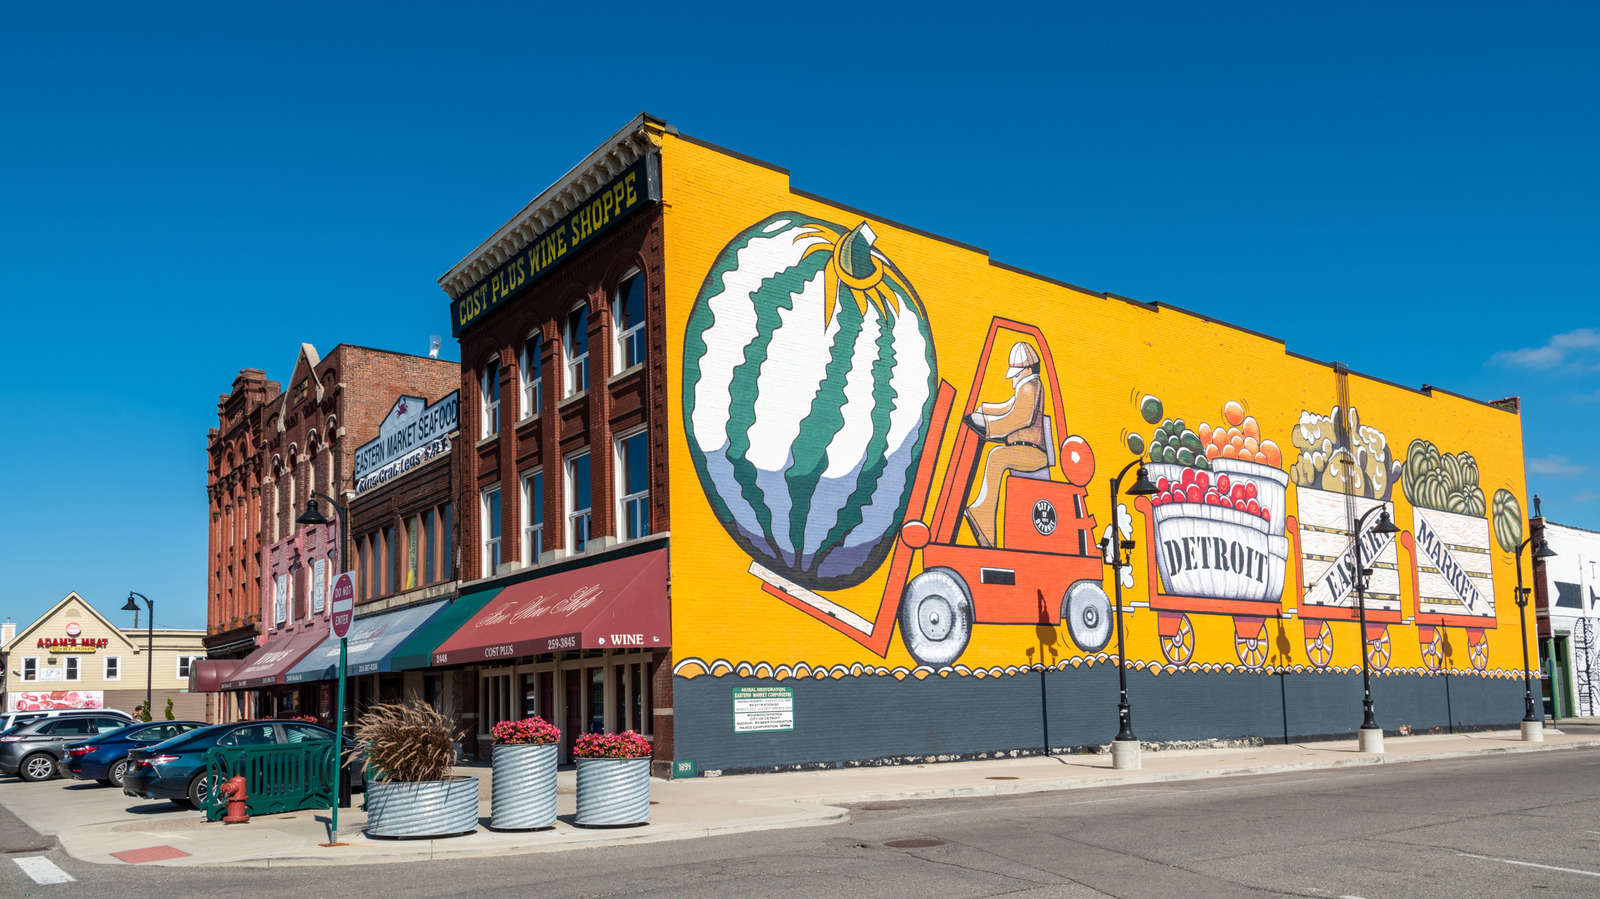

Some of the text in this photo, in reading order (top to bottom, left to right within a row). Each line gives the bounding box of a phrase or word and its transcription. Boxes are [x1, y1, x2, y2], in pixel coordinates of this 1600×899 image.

[459, 171, 637, 326] COST PLUS WINE SHOPPE
[356, 399, 457, 475] EASTERN MARKET SEAFOOD
[400, 451, 421, 473] Legs
[1037, 502, 1051, 512] CITY
[1035, 518, 1055, 532] DETROIT
[1164, 536, 1268, 583] DETROIT
[1325, 518, 1390, 603] EASERN
[1417, 519, 1479, 612] MARKET
[335, 585, 351, 598] DO NOT
[335, 614, 348, 626] ENTER
[37, 638, 108, 646] ADAM'S MEAT
[484, 646, 499, 658] COST
[499, 644, 514, 656] PLUS
[547, 636, 576, 650] 259-3845
[610, 633, 644, 645] WINE
[678, 762, 691, 771] 1894
